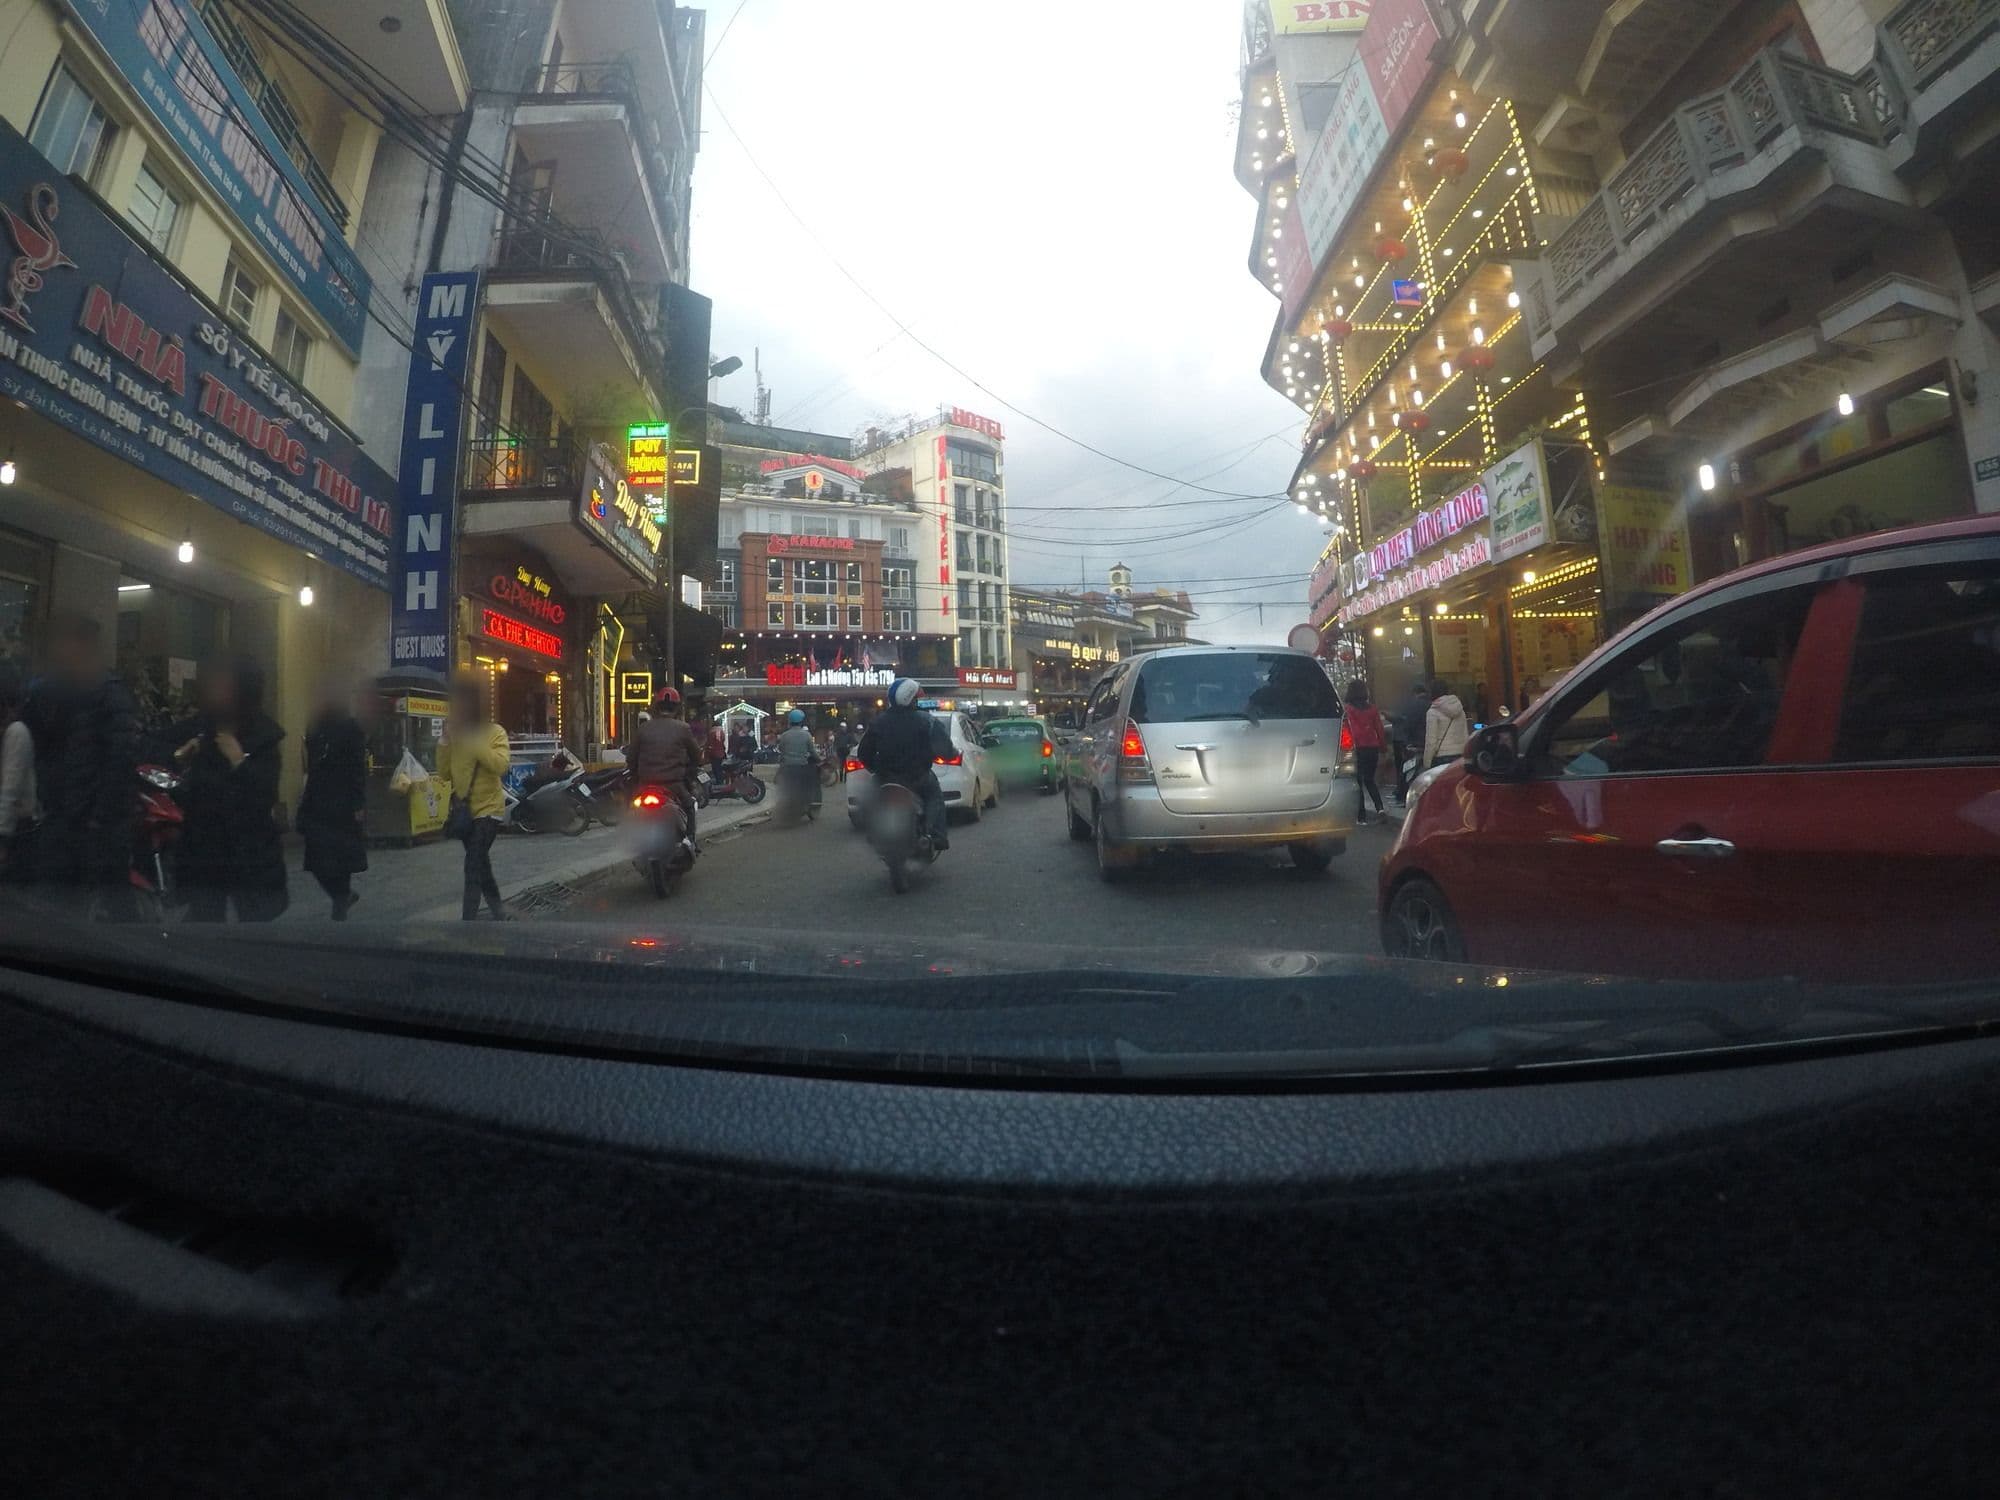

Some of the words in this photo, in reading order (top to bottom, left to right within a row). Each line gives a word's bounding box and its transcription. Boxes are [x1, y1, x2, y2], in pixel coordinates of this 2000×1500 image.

[1381, 15, 1416, 82] SAIGON
[200, 323, 231, 355] SỞ
[230, 349, 246, 369] Y
[248, 363, 272, 393] TẾ
[427, 284, 467, 371] MỸ
[18, 345, 69, 391] THUỐC
[69, 377, 107, 415] CHỮA
[106, 399, 142, 434] BỆNH
[166, 435, 190, 462] VẤN
[200, 460, 235, 491] HƯỚNG
[71, 343, 112, 383] NHÀ
[116, 372, 170, 419] THUỐC
[171, 409, 203, 440] ĐẠT
[204, 430, 248, 469] CHUẨN
[250, 460, 273, 482] GPP
[80, 284, 187, 398] NHÀ
[200, 371, 307, 476] THUỐC
[313, 457, 361, 514] THU
[406, 403, 444, 612] LINH
[614, 480, 639, 528] Duy
[1445, 483, 1486, 535] LONG
[790, 535, 854, 550] KARAOKE
[395, 636, 419, 659] GUEST
[420, 634, 446, 658] HOUSE
[821, 669, 828, 686] &
[996, 672, 1014, 685] Mart
